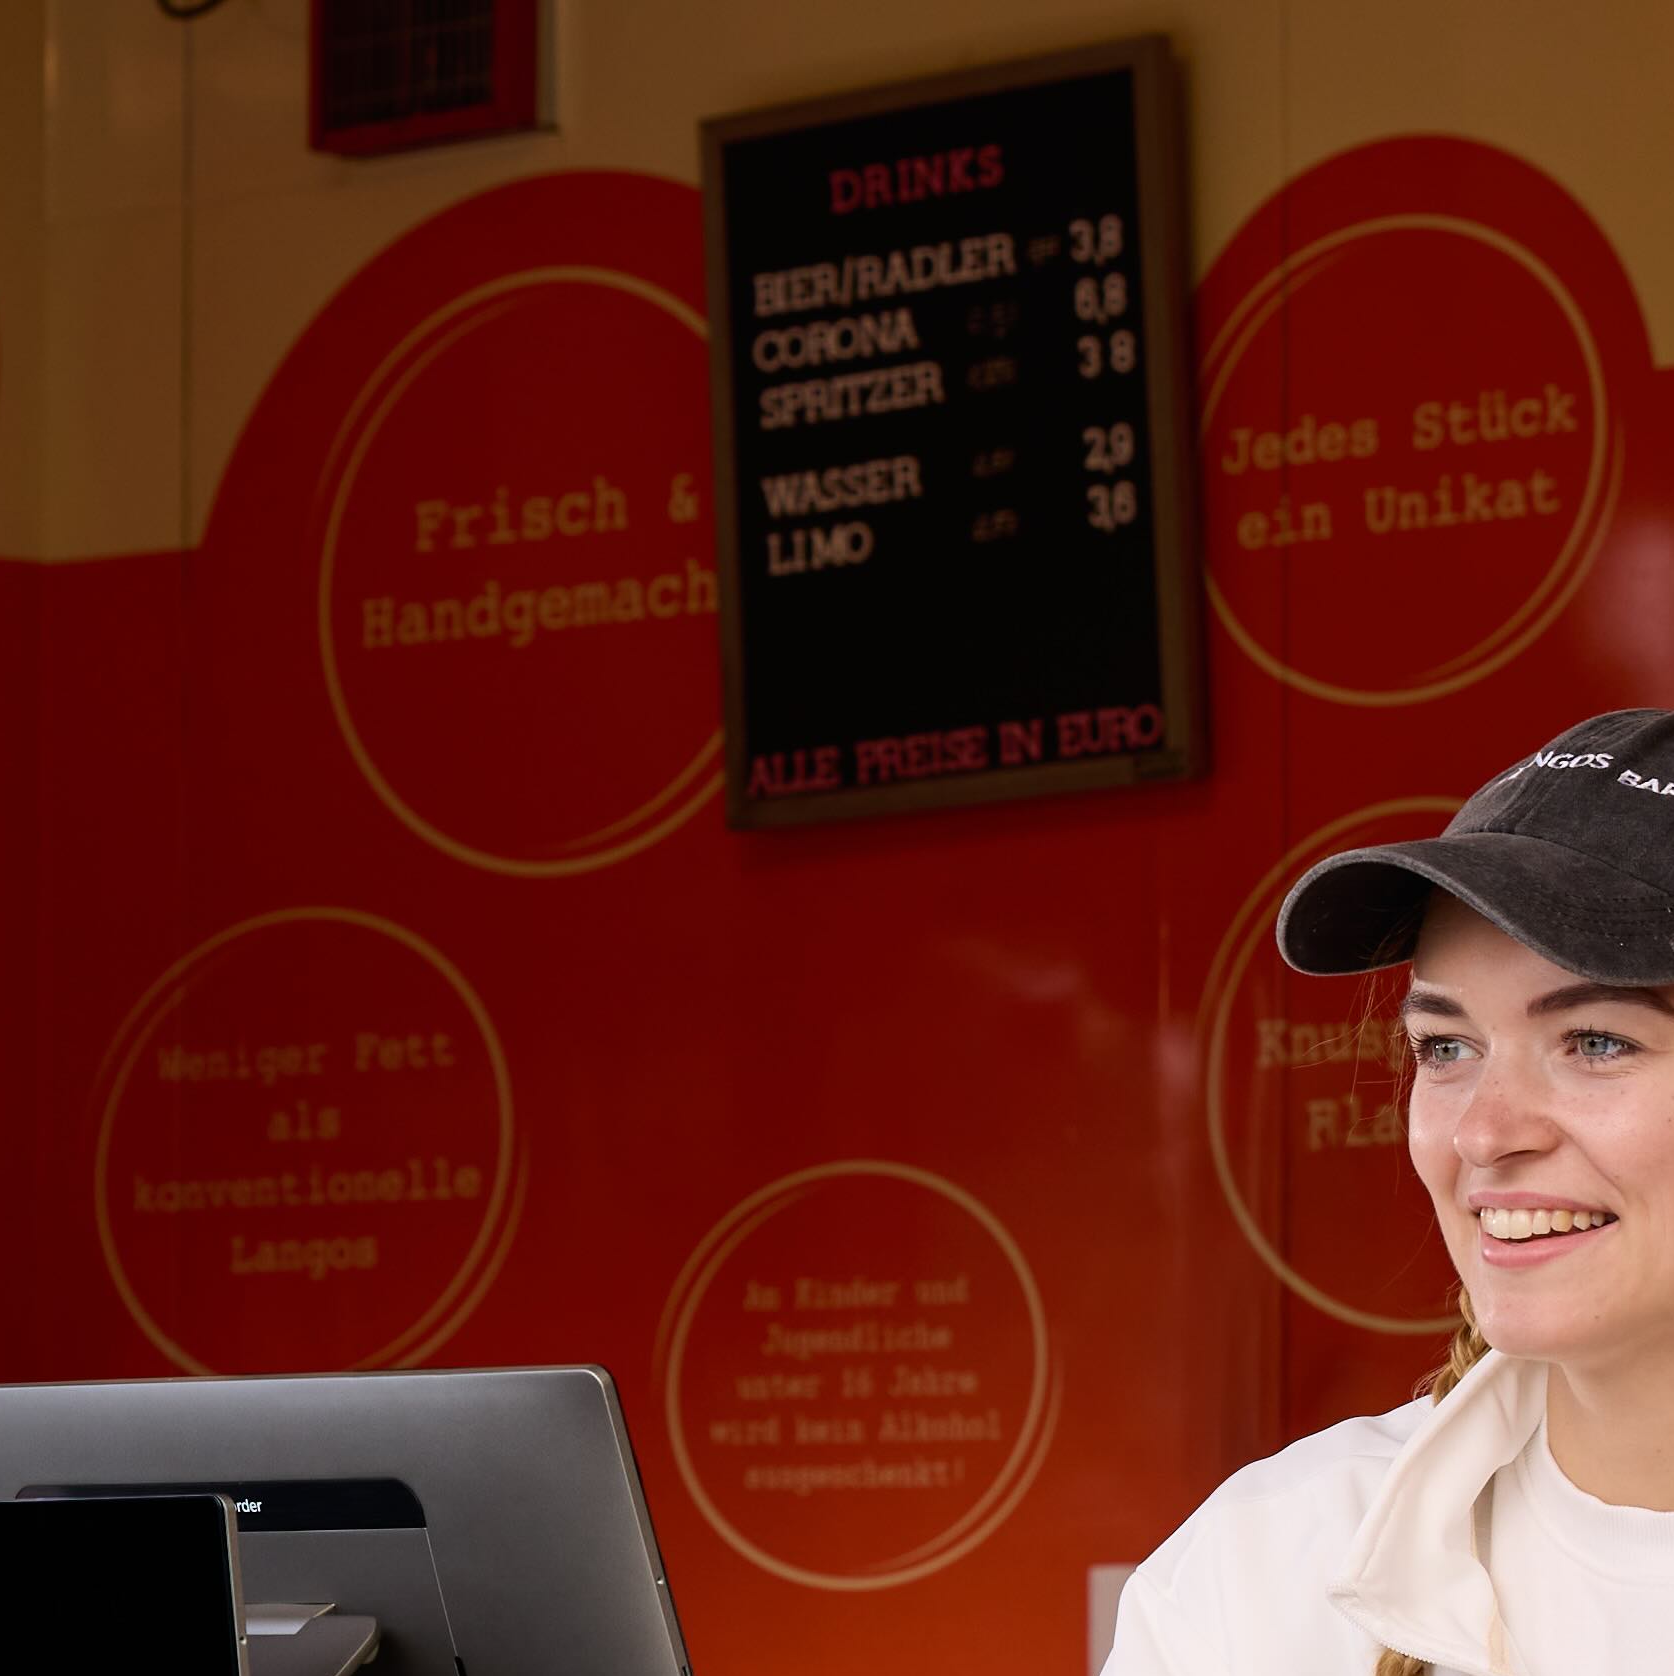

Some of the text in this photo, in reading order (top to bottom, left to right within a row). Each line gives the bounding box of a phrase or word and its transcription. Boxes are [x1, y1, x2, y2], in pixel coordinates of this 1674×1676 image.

[829, 145, 1006, 214] DRINKS
[753, 232, 1018, 317] BIER/RADLER
[752, 307, 922, 373] CORONA
[759, 360, 946, 430] SPRITZER
[1220, 382, 1580, 476] Jedes Stück
[413, 472, 699, 555] Frisch &
[759, 455, 923, 518] WASSER
[1236, 469, 1563, 551] ein Unikat
[766, 521, 875, 577] LIMO
[748, 704, 1165, 796] ALLE PREISE IN EURO
[156, 1028, 457, 1088] Weniger Fett
[266, 1099, 342, 1143] als
[131, 1156, 483, 1214] konventionelle
[228, 1234, 380, 1282] Langos
